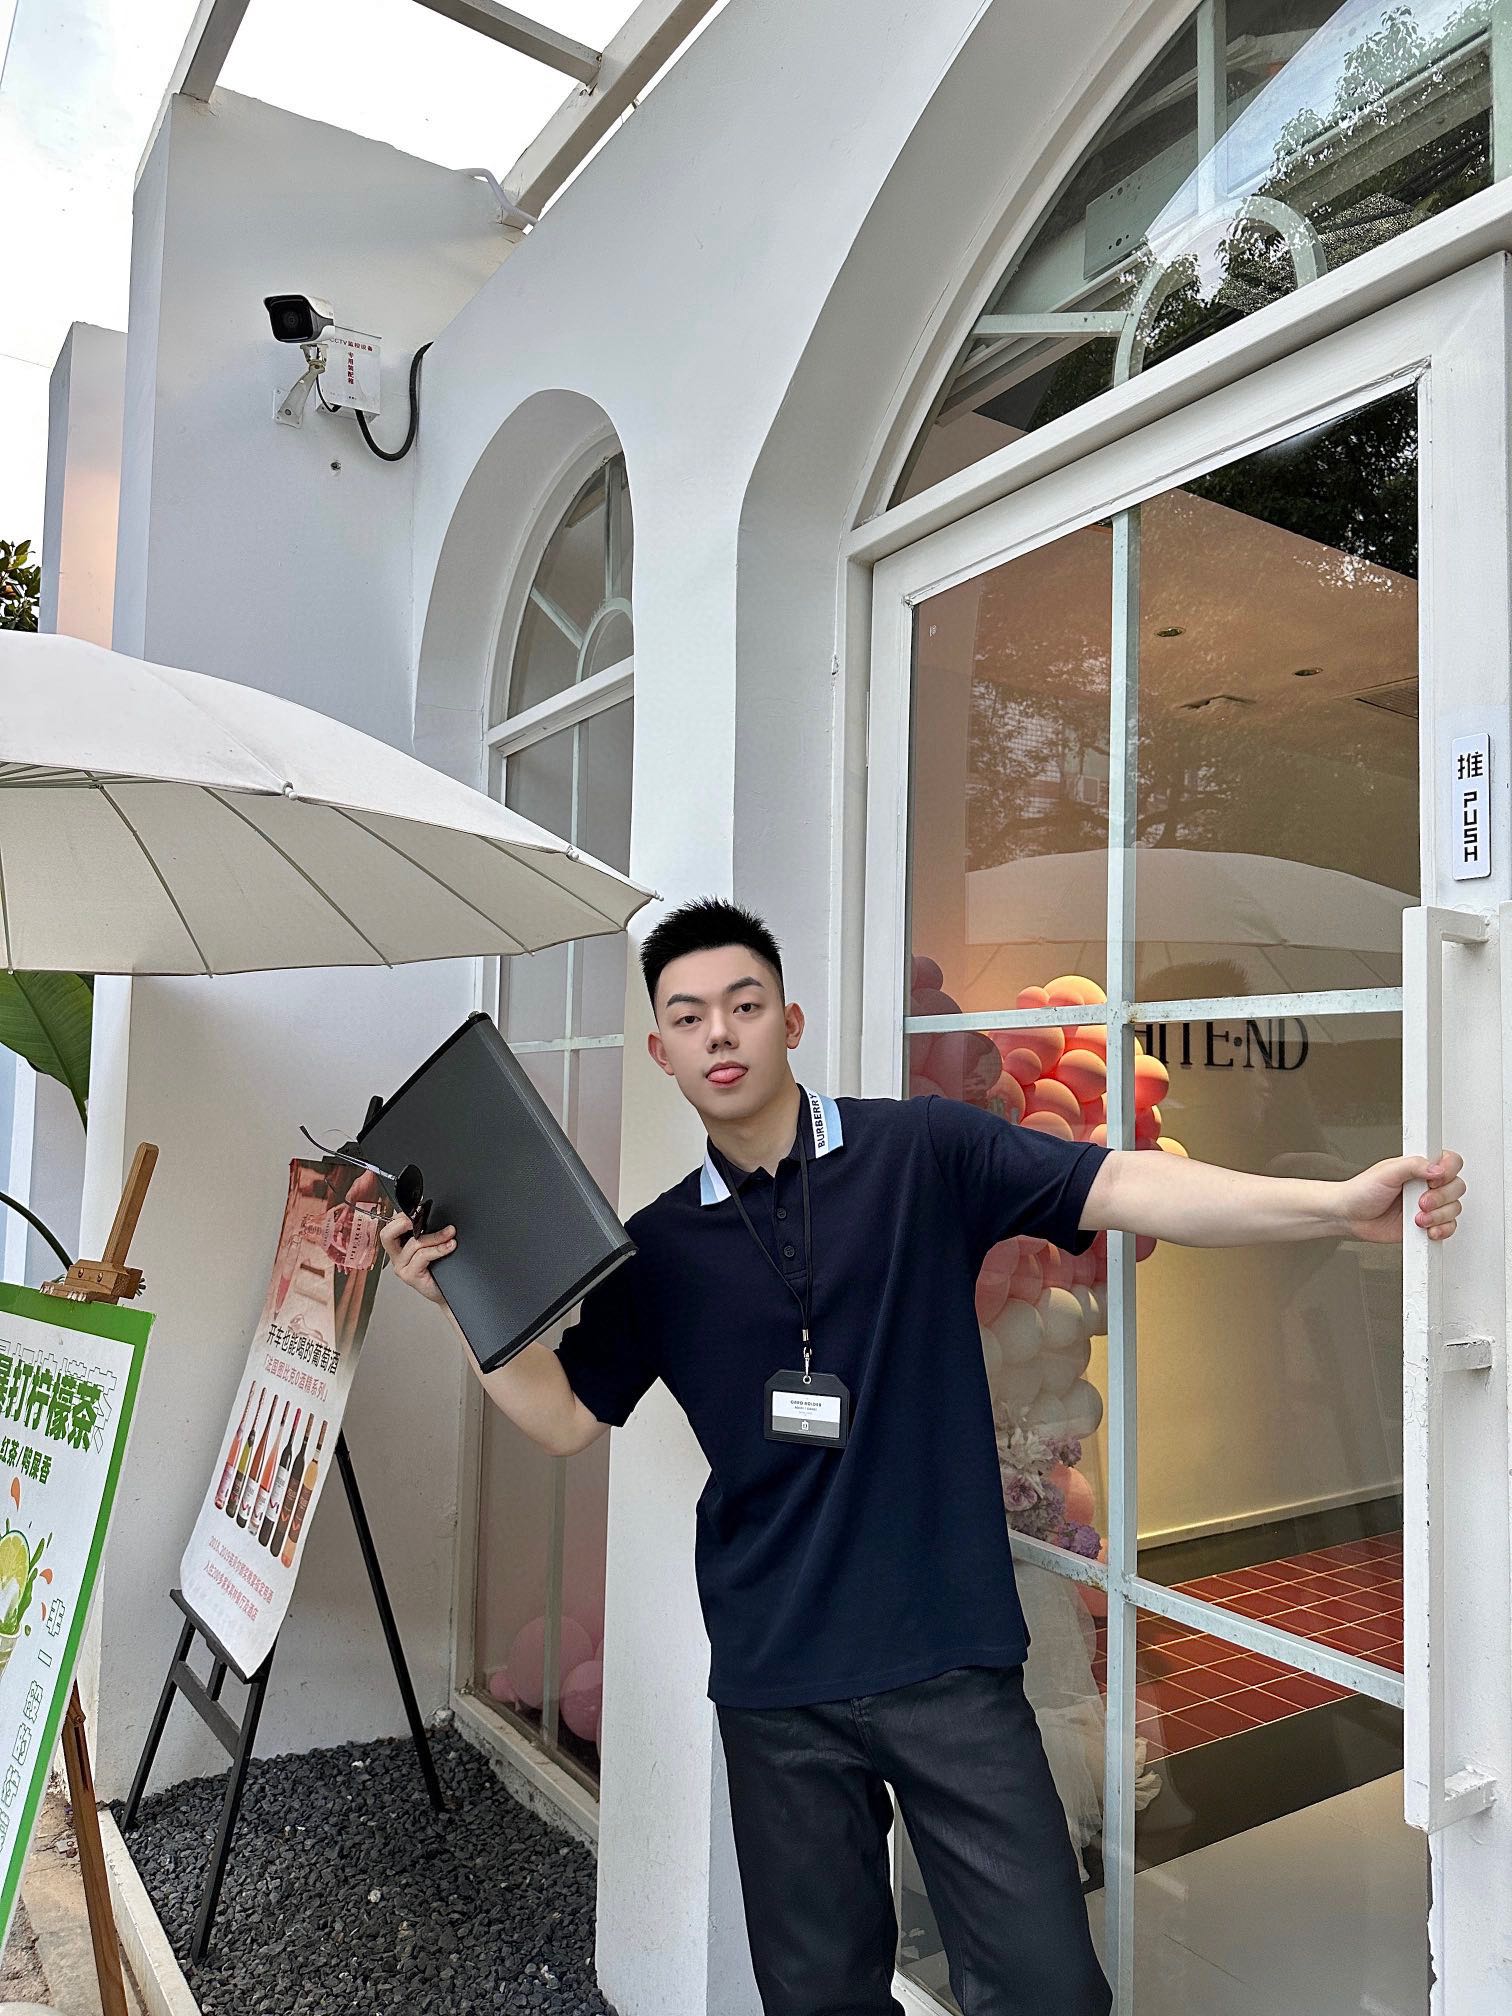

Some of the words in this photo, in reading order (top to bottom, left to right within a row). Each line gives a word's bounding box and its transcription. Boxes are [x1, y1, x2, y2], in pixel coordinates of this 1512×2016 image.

[1457, 751, 1484, 780] 推
[1463, 790, 1478, 862] PUSH
[808, 1093, 826, 1148] BURBERRY
[266, 1323, 341, 1376] 开车也能喝的葡萄酒
